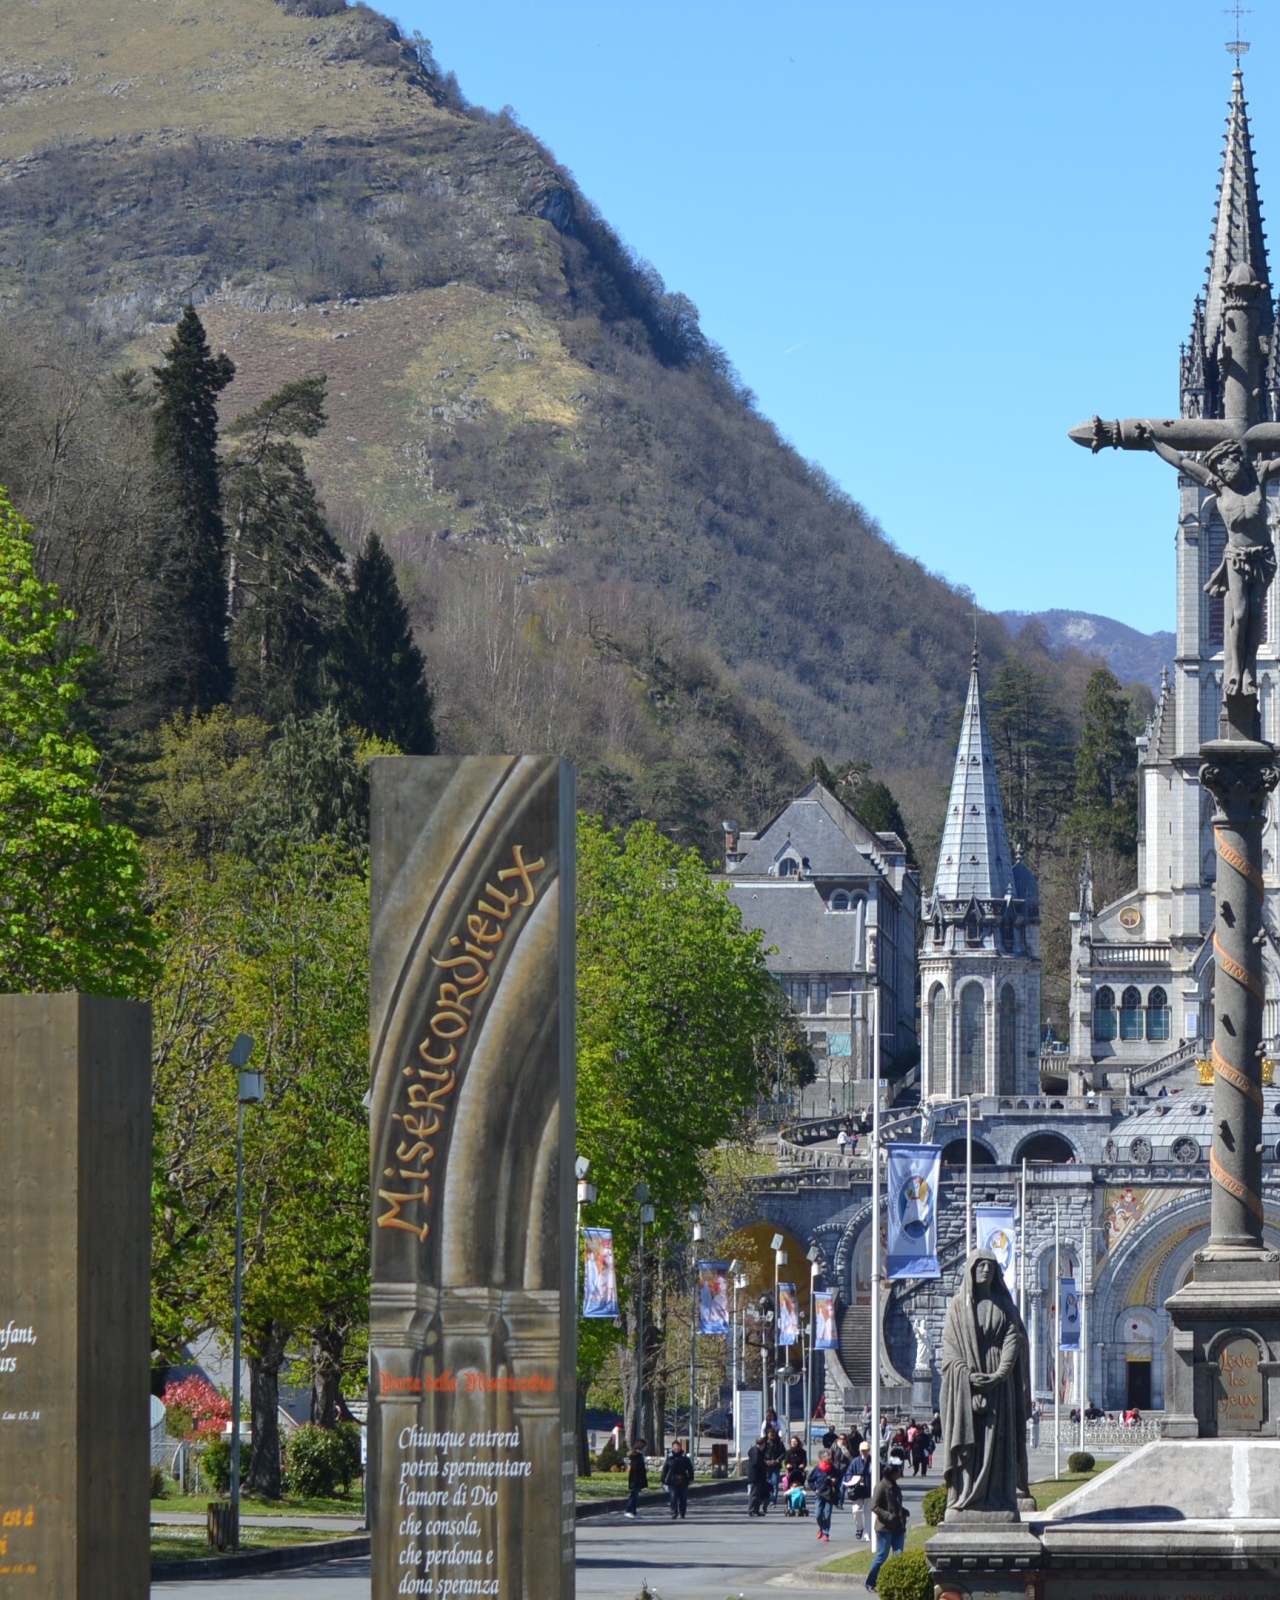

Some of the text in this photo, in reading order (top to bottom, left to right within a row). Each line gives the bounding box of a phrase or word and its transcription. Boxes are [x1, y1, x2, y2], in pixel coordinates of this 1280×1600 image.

[380, 1370, 555, 1397] Porta della Misericordia
[1217, 1394, 1257, 1413] yeux
[398, 1424, 520, 1455] Chiunque entrerà
[400, 1455, 532, 1484] potrà sperimentare
[399, 1483, 498, 1507] l'amore di Dio
[399, 1512, 481, 1537] che consola,
[399, 1542, 494, 1572] che perdona e
[399, 1571, 500, 1600] dona speranza
